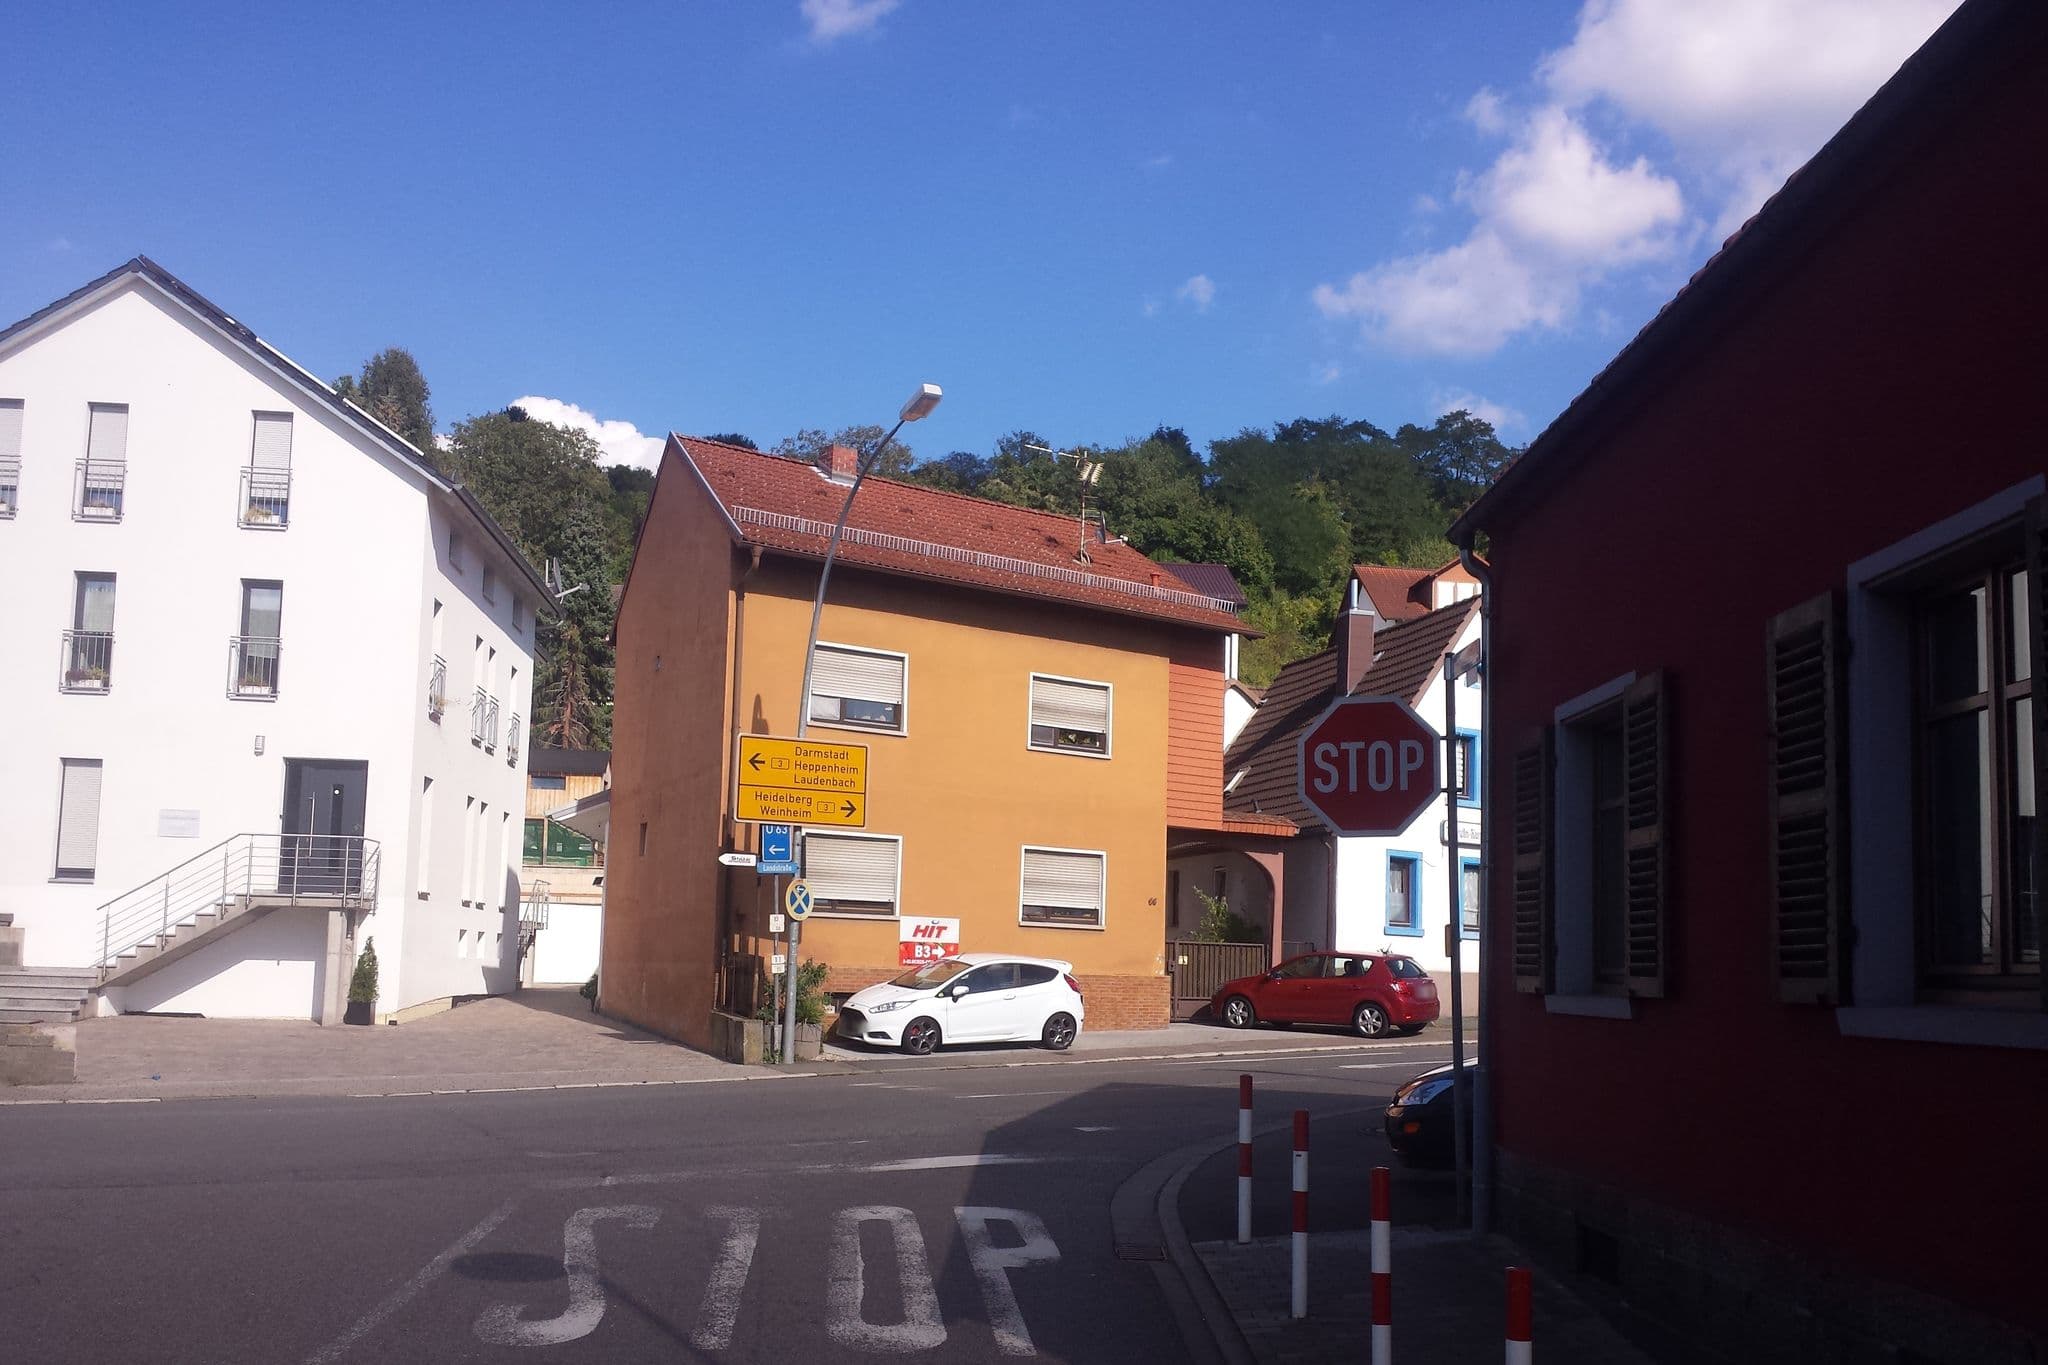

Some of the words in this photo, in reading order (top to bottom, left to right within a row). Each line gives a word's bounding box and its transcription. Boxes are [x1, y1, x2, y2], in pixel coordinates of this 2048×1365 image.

[795, 746, 850, 760] Darmstadt
[777, 760, 783, 768] 3
[794, 760, 859, 775] Heppenheim
[1313, 739, 1425, 794] STOP
[794, 774, 856, 788] Laudenbach
[754, 791, 813, 807] Heidelberg
[759, 805, 812, 818] Weinheim
[823, 804, 829, 812] 3
[912, 922, 948, 938] HIT
[914, 944, 931, 958] B3
[471, 1203, 1063, 1358] STOP
